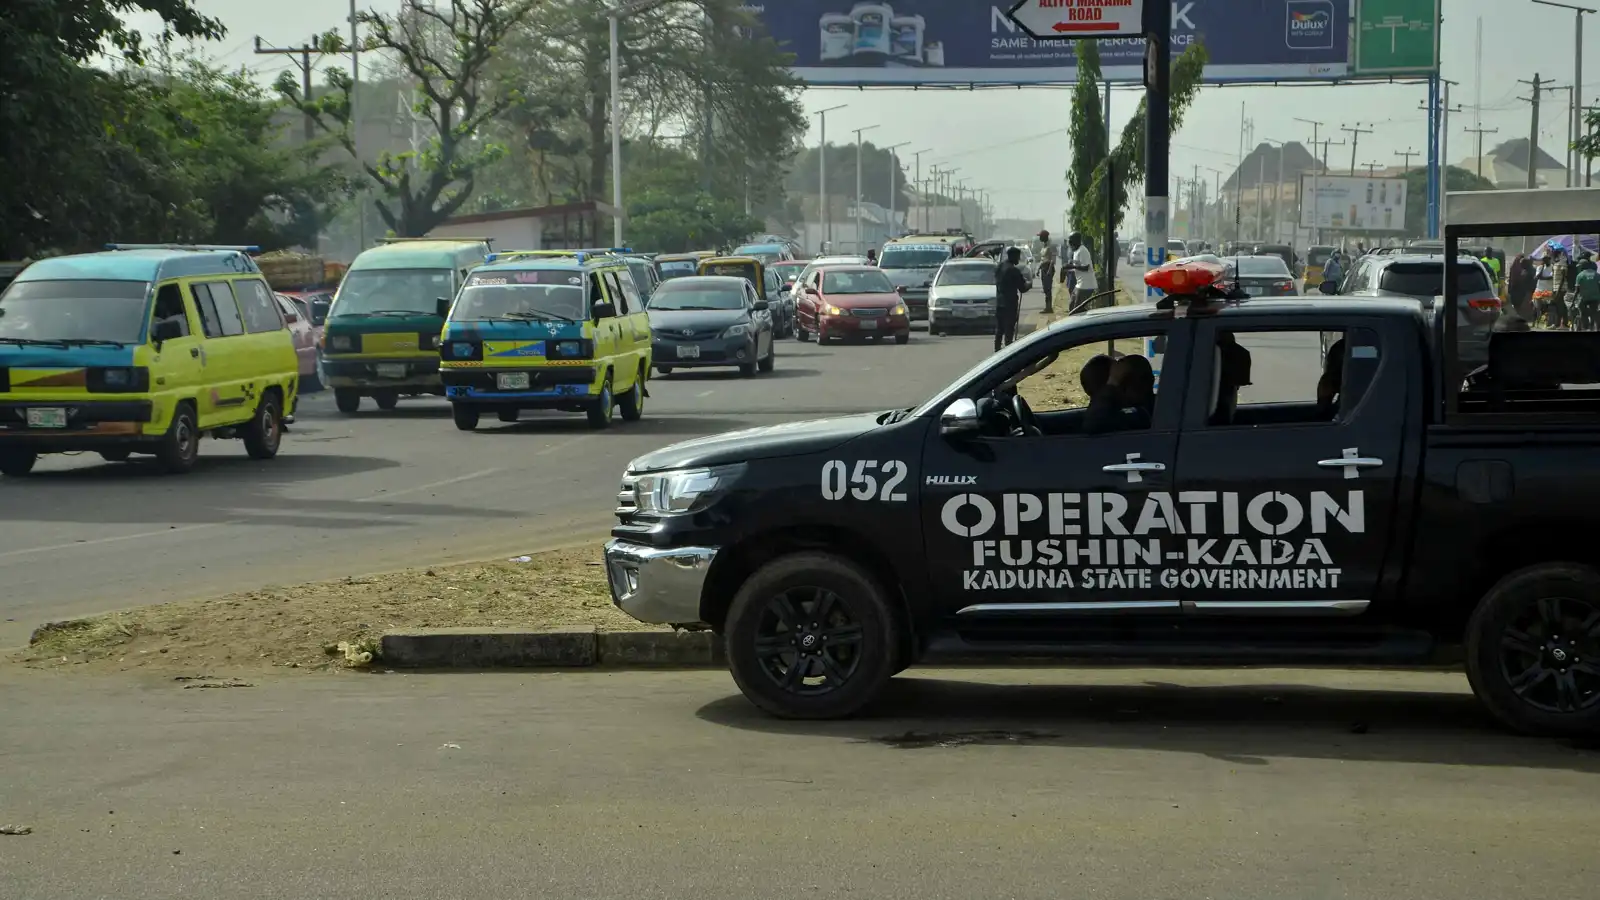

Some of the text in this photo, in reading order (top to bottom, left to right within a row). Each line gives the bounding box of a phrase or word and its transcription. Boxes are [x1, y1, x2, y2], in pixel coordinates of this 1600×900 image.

[1068, 8, 1102, 20] ROAD
[1291, 19, 1324, 29] Dulux
[991, 37, 1028, 48] SAME
[1031, 38, 1077, 48] TIMELE
[821, 459, 908, 502] 052
[925, 474, 978, 485] HILUX
[941, 490, 1366, 537] OPERATION
[972, 537, 1335, 566] FUSHIN-KADA
[963, 567, 1342, 590] KADUNA STATE GOVERNMENT
